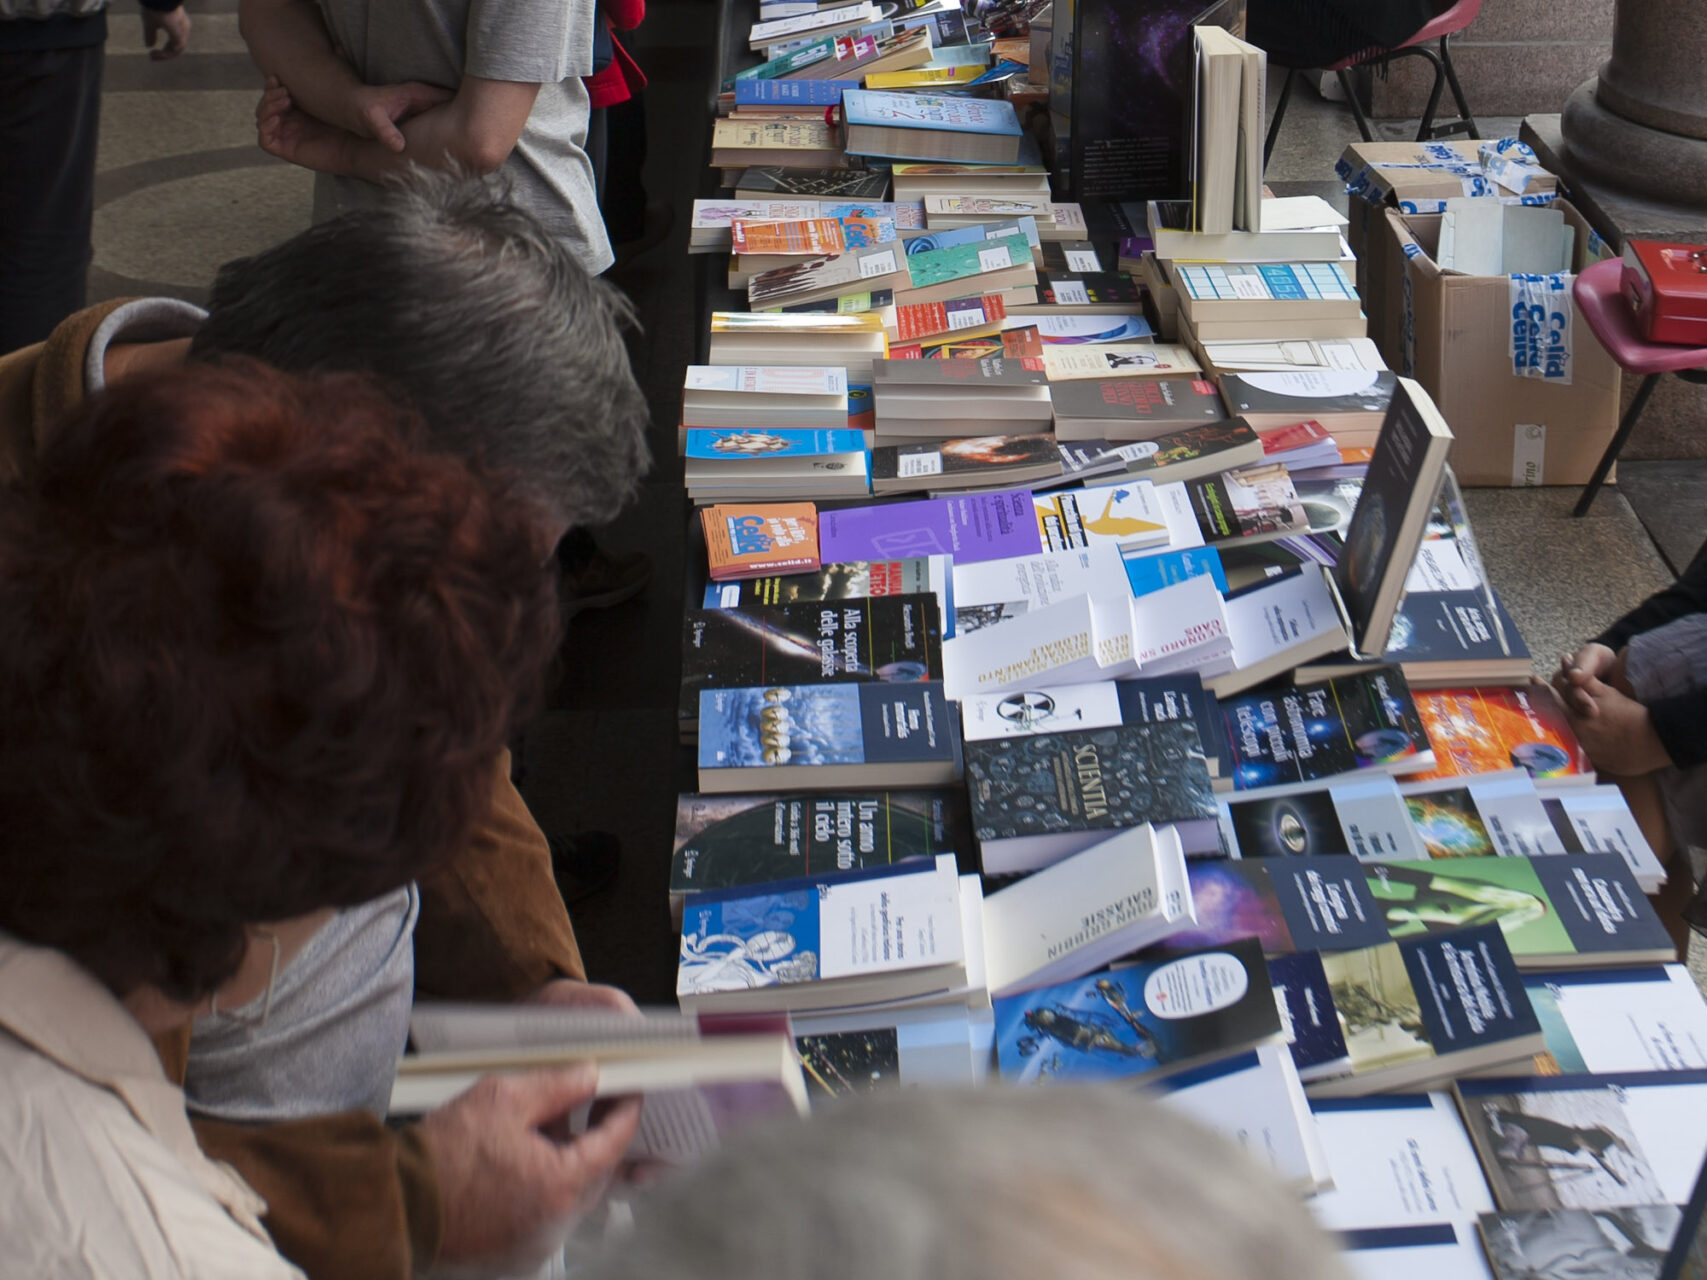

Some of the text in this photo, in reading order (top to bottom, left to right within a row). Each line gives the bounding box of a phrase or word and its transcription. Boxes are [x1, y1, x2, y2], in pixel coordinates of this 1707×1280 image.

[1545, 312, 1571, 379] Celid
[736, 515, 773, 555] Celid
[817, 610, 838, 677] delle galassie
[842, 608, 861, 672] Alla scoperta
[1233, 704, 1267, 757] telescopi
[1259, 700, 1293, 762] con piccoli
[1283, 695, 1320, 759] astronomia
[1306, 689, 1329, 717] Fare
[1072, 743, 1110, 821] SCIENTIA
[815, 801, 836, 841] il cielo
[837, 801, 857, 869] intero sotto
[859, 800, 879, 853] Un anno
[1082, 887, 1153, 929] GALASSIE
